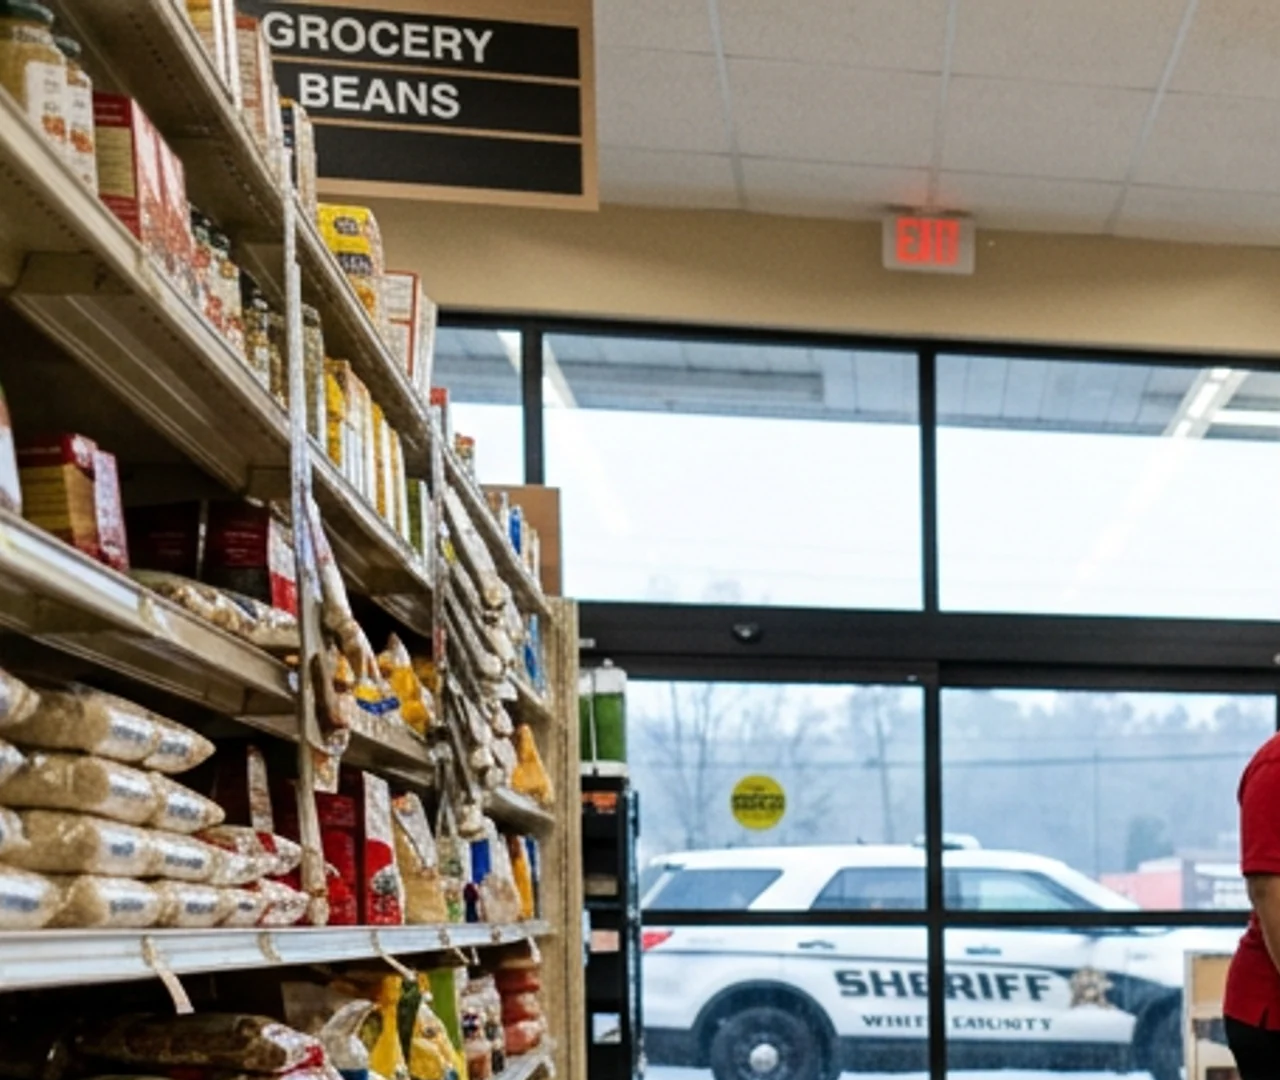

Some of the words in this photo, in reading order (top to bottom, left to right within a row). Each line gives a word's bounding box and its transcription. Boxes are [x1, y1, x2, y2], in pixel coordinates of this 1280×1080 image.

[262, 11, 493, 63] GROCERY
[298, 73, 460, 119] BEANS
[834, 970, 1051, 1001] SHERIFF
